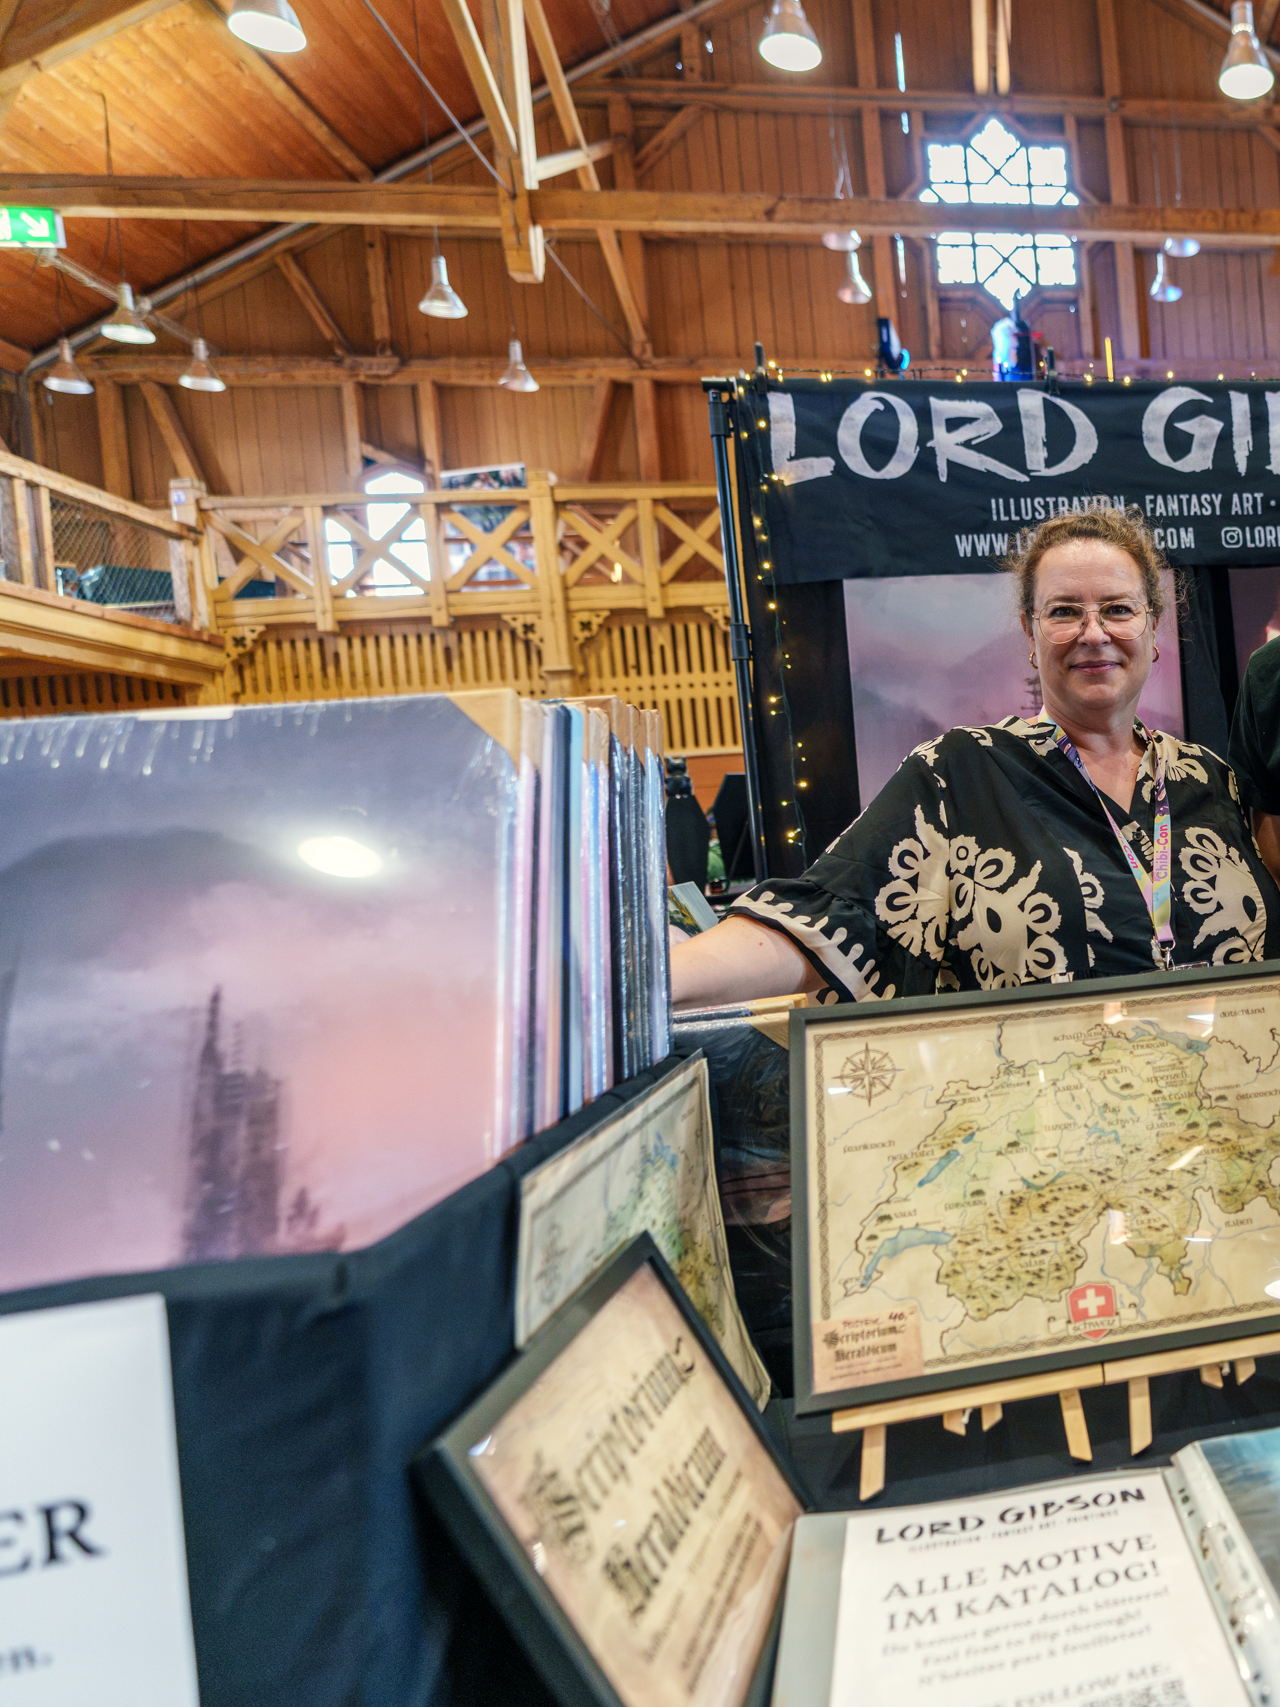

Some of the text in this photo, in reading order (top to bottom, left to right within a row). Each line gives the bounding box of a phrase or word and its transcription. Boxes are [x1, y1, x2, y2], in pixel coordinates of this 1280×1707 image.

[767, 388, 1098, 486] LORD
[991, 495, 1125, 521] ILLUSTRATION
[1145, 493, 1222, 517] FANTASY
[1231, 492, 1264, 515] ART
[1155, 824, 1169, 880] Chibi-Con
[876, 1487, 1146, 1546] LORD GIBSON
[882, 1534, 1158, 1603] ALLE MOTIVE
[885, 1560, 1160, 1633] IM KATALOG!
